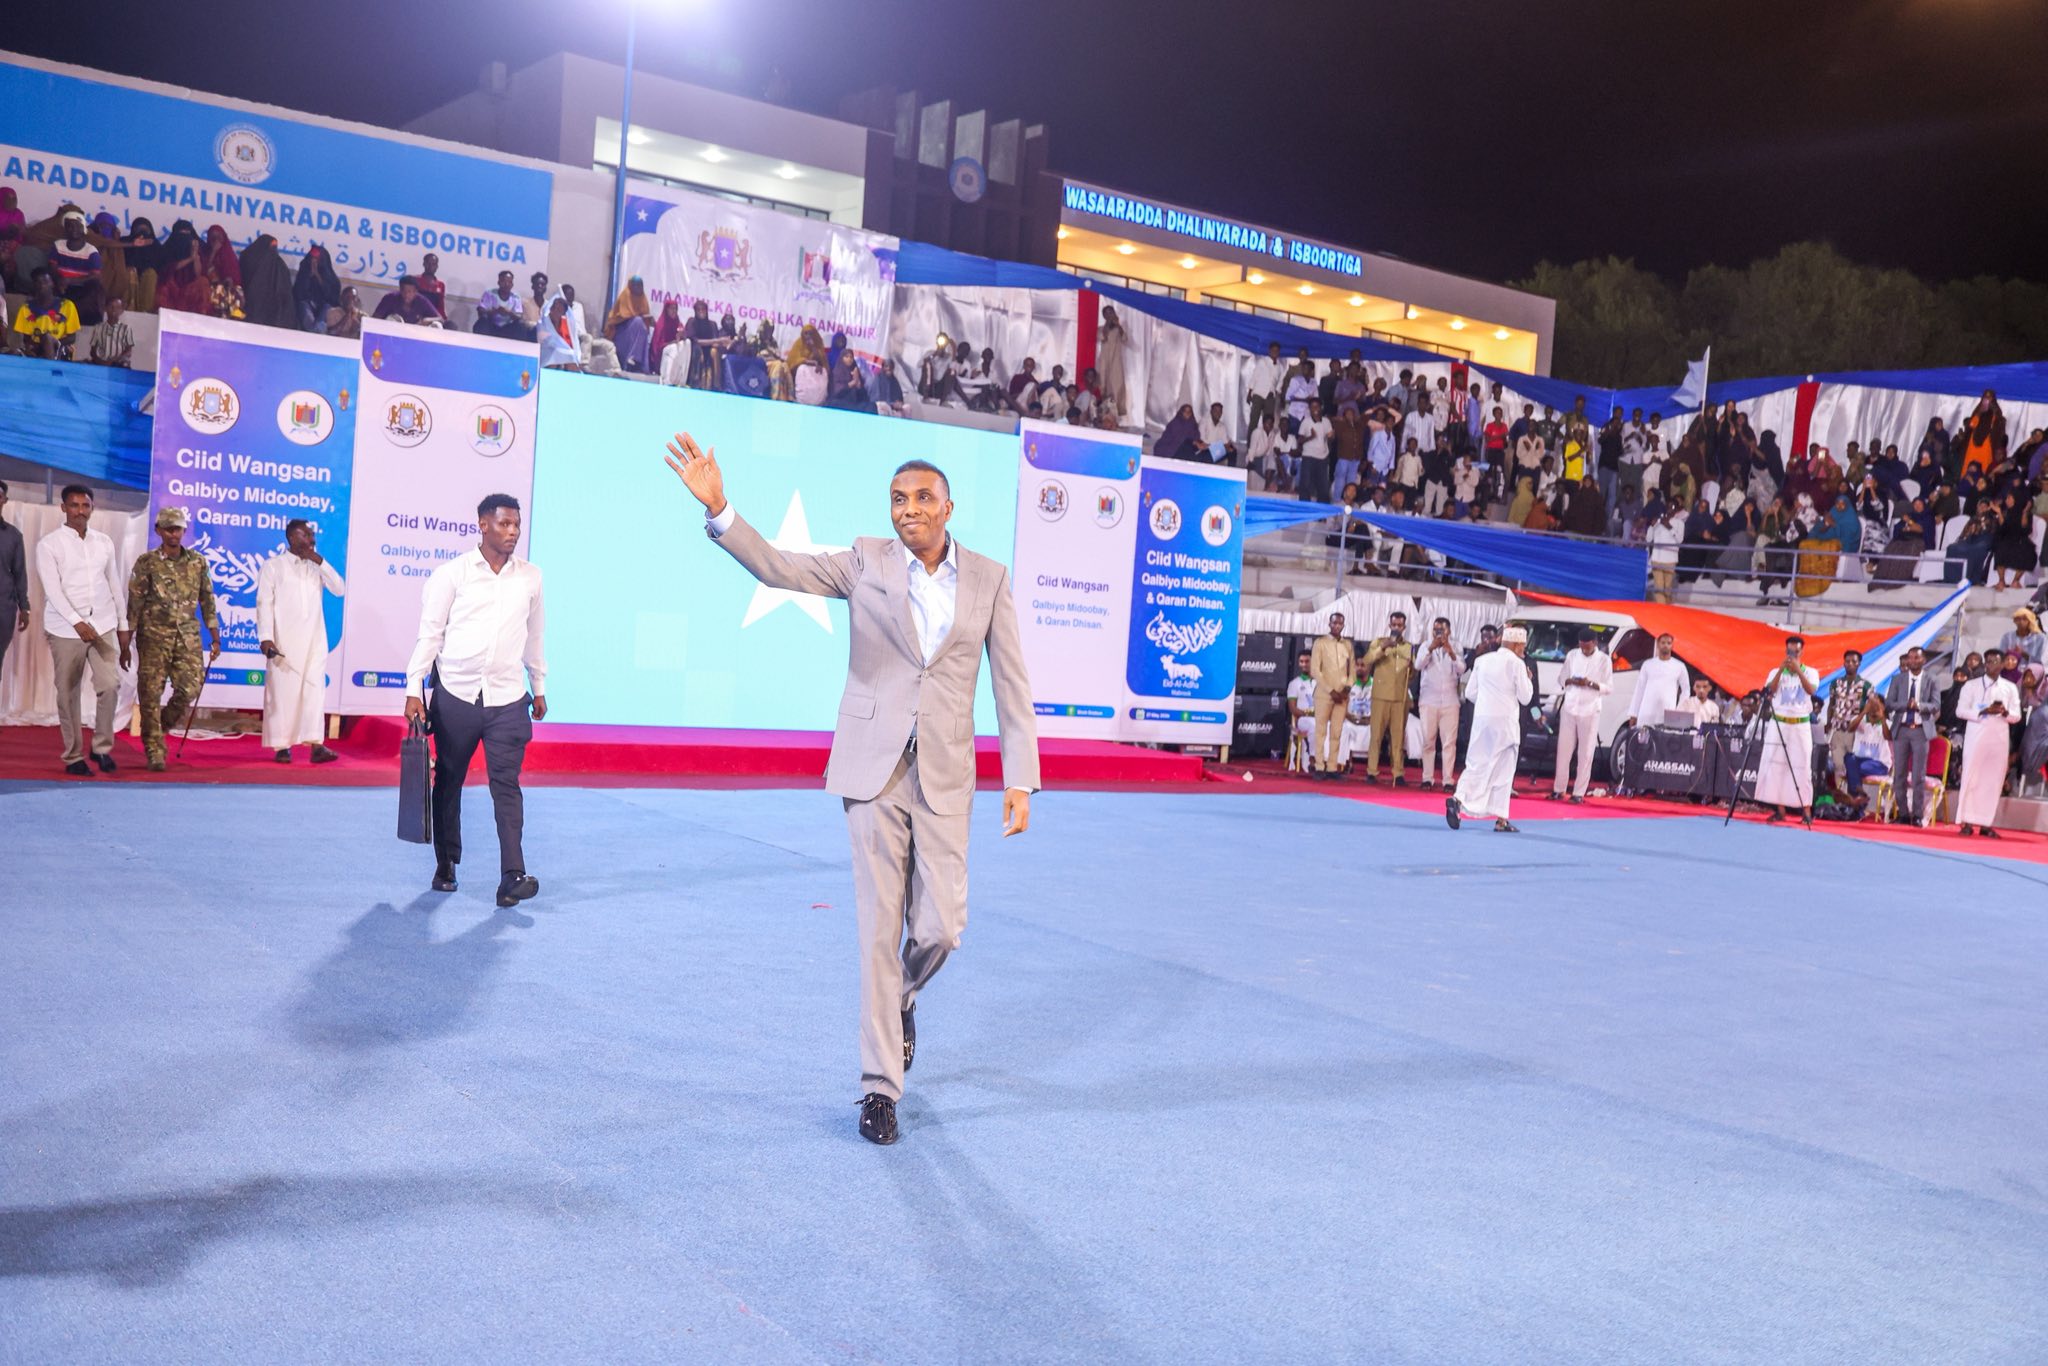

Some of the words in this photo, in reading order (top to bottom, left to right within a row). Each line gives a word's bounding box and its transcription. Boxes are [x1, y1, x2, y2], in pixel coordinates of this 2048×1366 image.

[0, 156, 130, 198] ARADDA
[139, 179, 350, 234] DHALINYARADA
[357, 217, 374, 239] &
[381, 221, 527, 265] ISBOORTIGA
[1064, 186, 1164, 228] WASAARADDA
[1166, 211, 1267, 253] DHALINYARADA
[1272, 236, 1284, 258] &
[1289, 240, 1362, 276] ISBOORTIGA
[176, 447, 222, 471] Ciid
[228, 453, 331, 483] Wangsan
[168, 479, 240, 502] Qalbiyo
[244, 486, 335, 513] Midoobay,
[196, 507, 252, 528] Qaran
[387, 513, 419, 529] Ciid
[380, 544, 431, 561] Qalbiyo
[387, 564, 397, 575] &
[401, 564, 433, 578] Qara
[1174, 553, 1231, 574] Wangsan
[1061, 577, 1110, 594] Wangsan
[1156, 592, 1187, 608] Qaran
